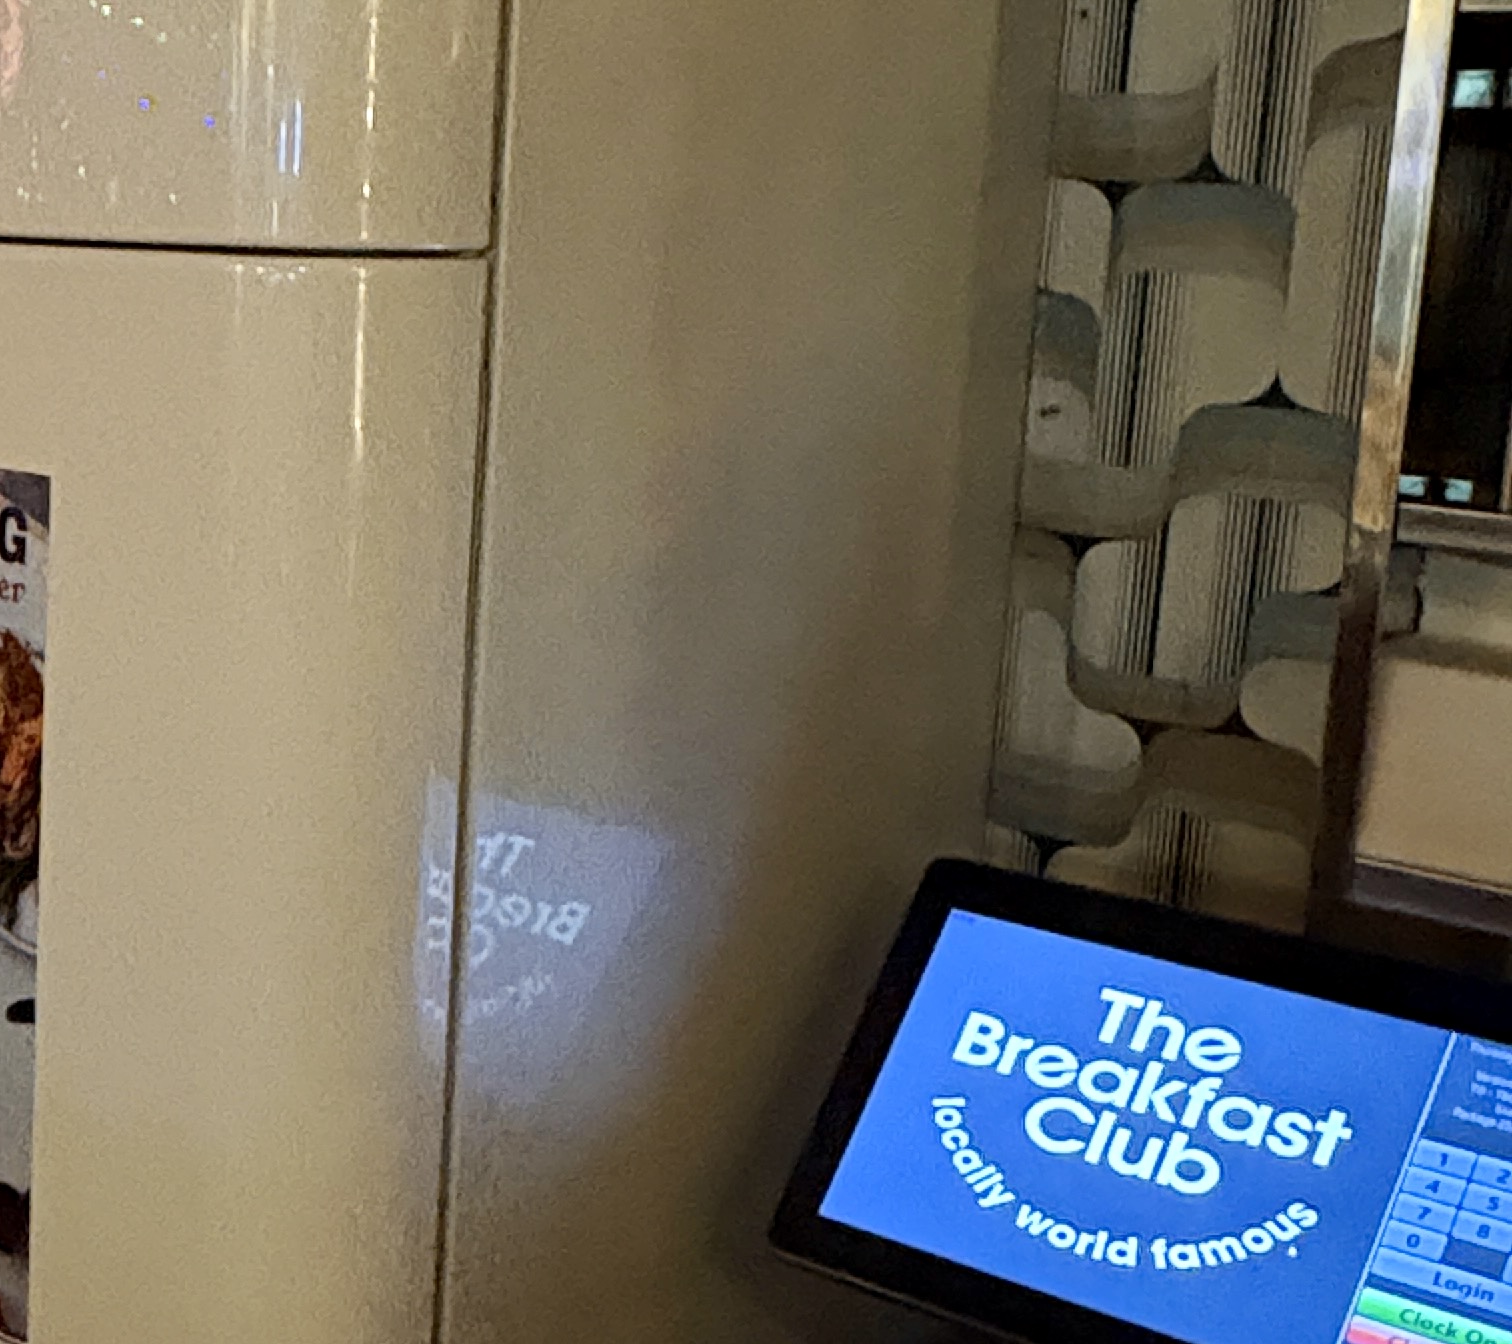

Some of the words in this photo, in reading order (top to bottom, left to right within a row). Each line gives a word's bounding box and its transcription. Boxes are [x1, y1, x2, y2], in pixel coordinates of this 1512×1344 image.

[1099, 987, 1242, 1073] The
[952, 1011, 1352, 1167] Breakfast
[1024, 1096, 1221, 1196] Club
[932, 1096, 1016, 1208] locally
[1015, 1203, 1138, 1268] world
[1406, 1234, 1420, 1248] 0
[1417, 1206, 1432, 1221] 7
[1476, 1224, 1491, 1239] 8
[1433, 1270, 1494, 1302] Login
[1399, 1309, 1458, 1338] Clock
